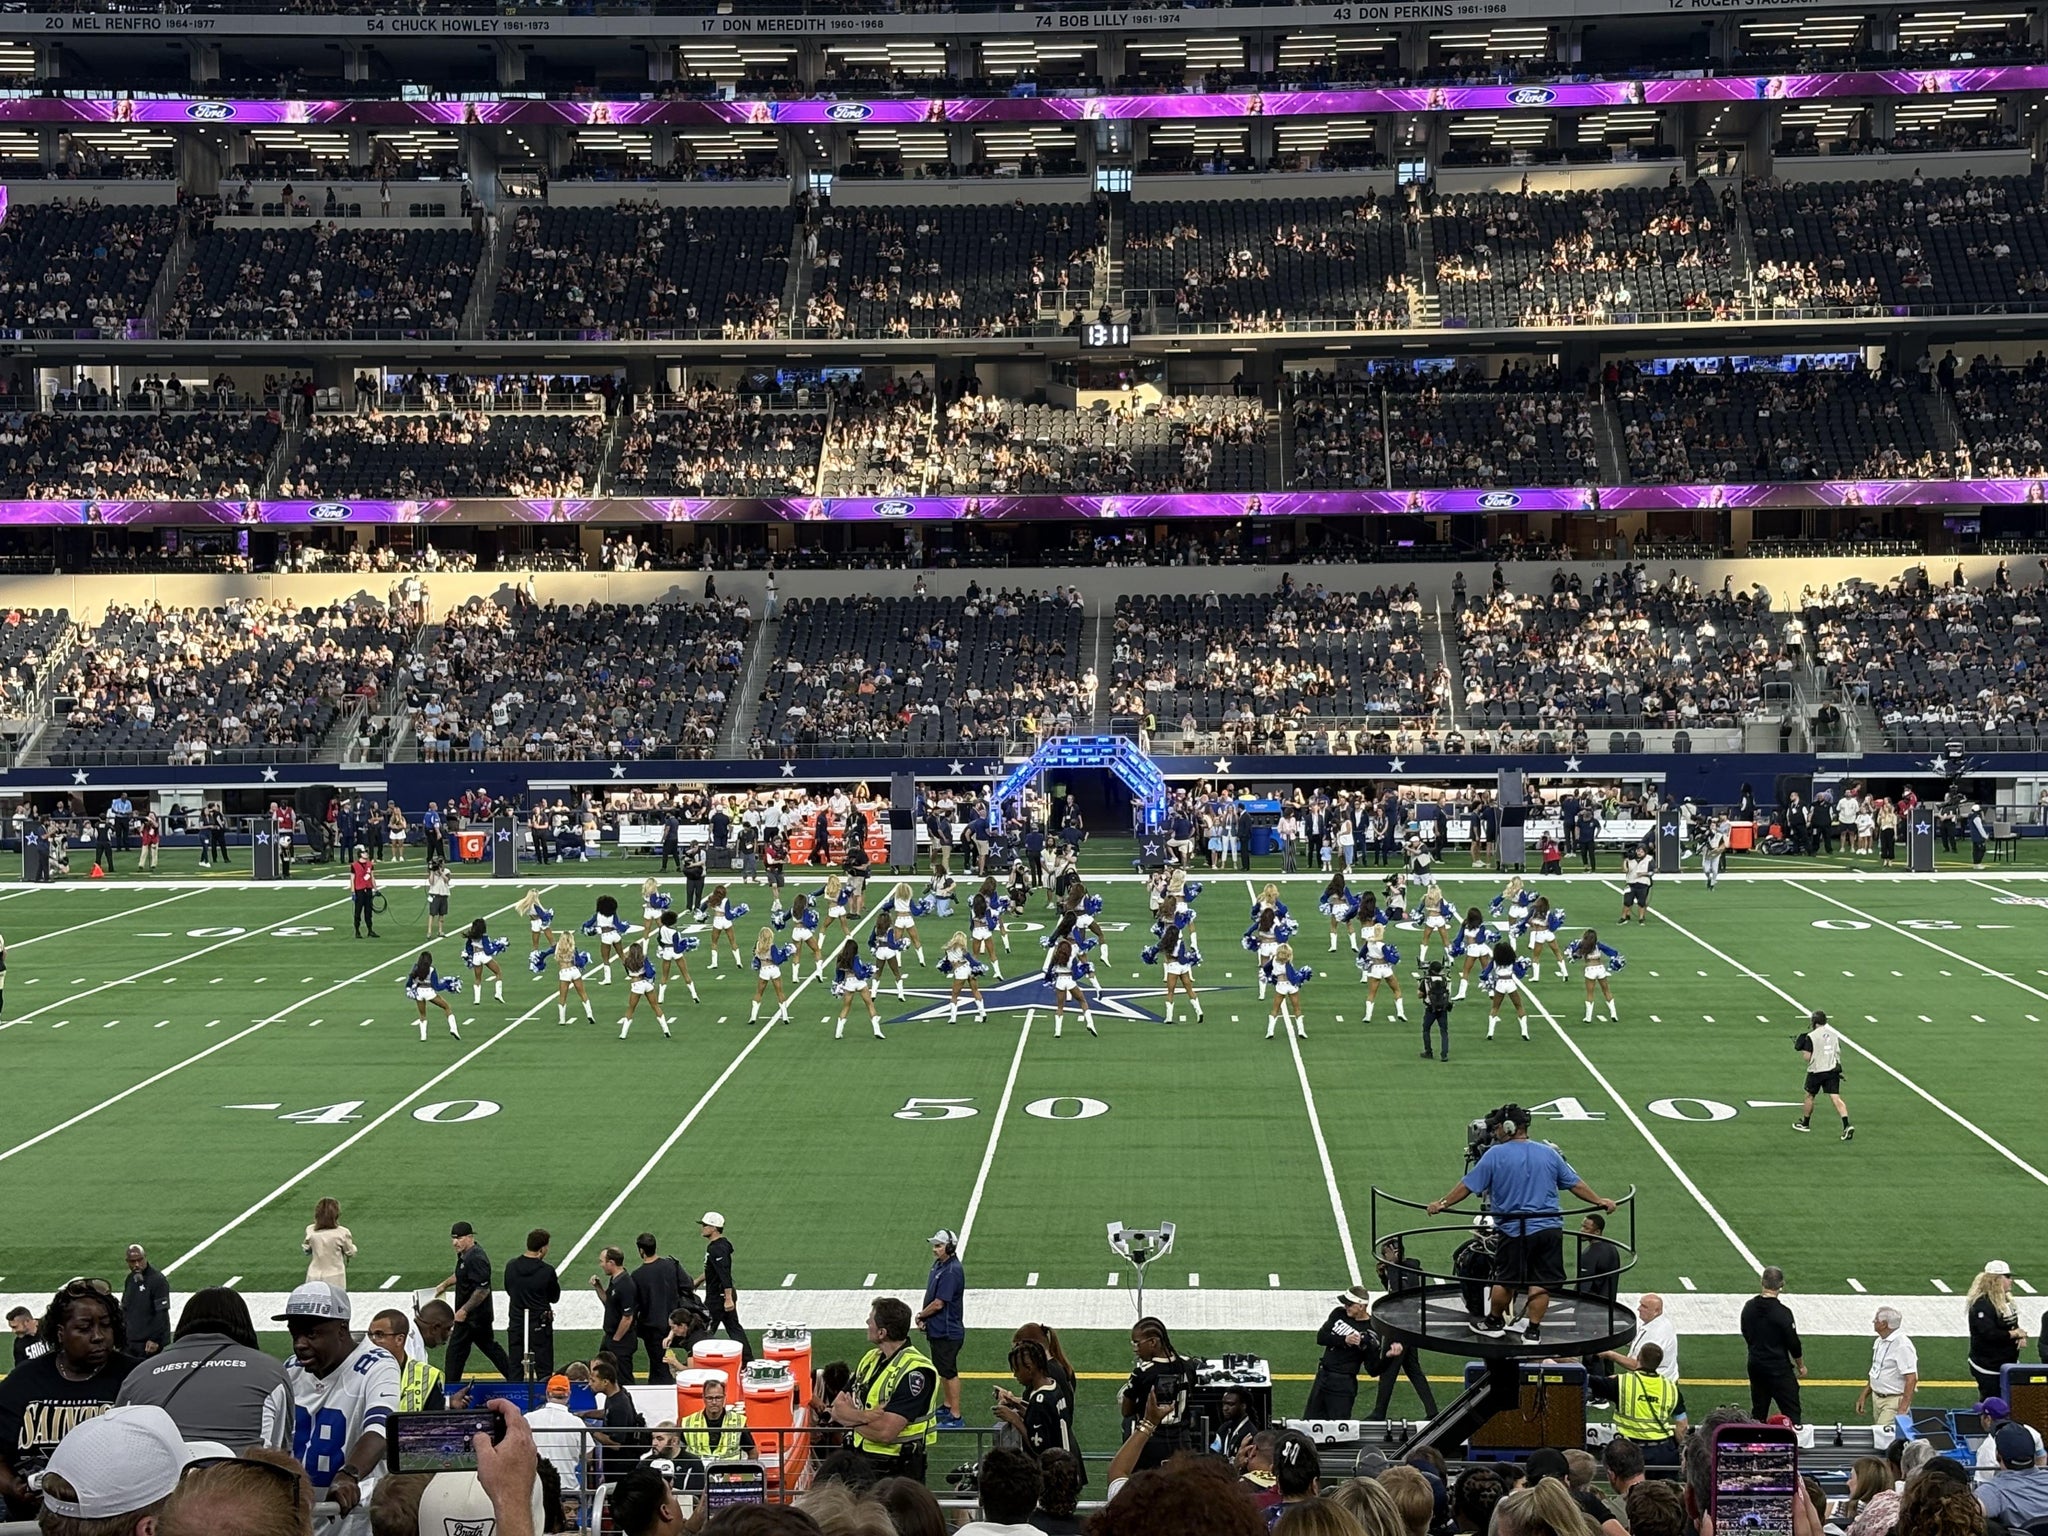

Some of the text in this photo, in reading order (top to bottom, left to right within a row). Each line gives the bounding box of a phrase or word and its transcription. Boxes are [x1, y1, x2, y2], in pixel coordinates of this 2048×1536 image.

[1333, 4, 1507, 20] 43 DON PERKINS 1961-1968
[45, 18, 216, 29] 20 MEL RENFRO 1964-1977
[367, 20, 550, 31] 54 CHUCK HOWLEY 1961-1973
[701, 19, 884, 31] 17 DON MEREDITH 1960-1968
[1035, 14, 1180, 27] 74 BOB LILLY 1961-1974
[1515, 90, 1547, 103] Ford
[194, 104, 227, 118] Ford
[833, 105, 865, 118] Ford
[1088, 324, 1129, 346] 13:11
[1484, 494, 1514, 506] Ford
[315, 505, 345, 517] Ford
[880, 502, 908, 515] Ford
[466, 838, 480, 852] G
[796, 839, 804, 847] G
[871, 853, 879, 861] G
[152, 1359, 247, 1375] GUEST SRVICES
[1312, 1423, 1323, 1434] G
[1586, 1428, 1598, 1439] G
